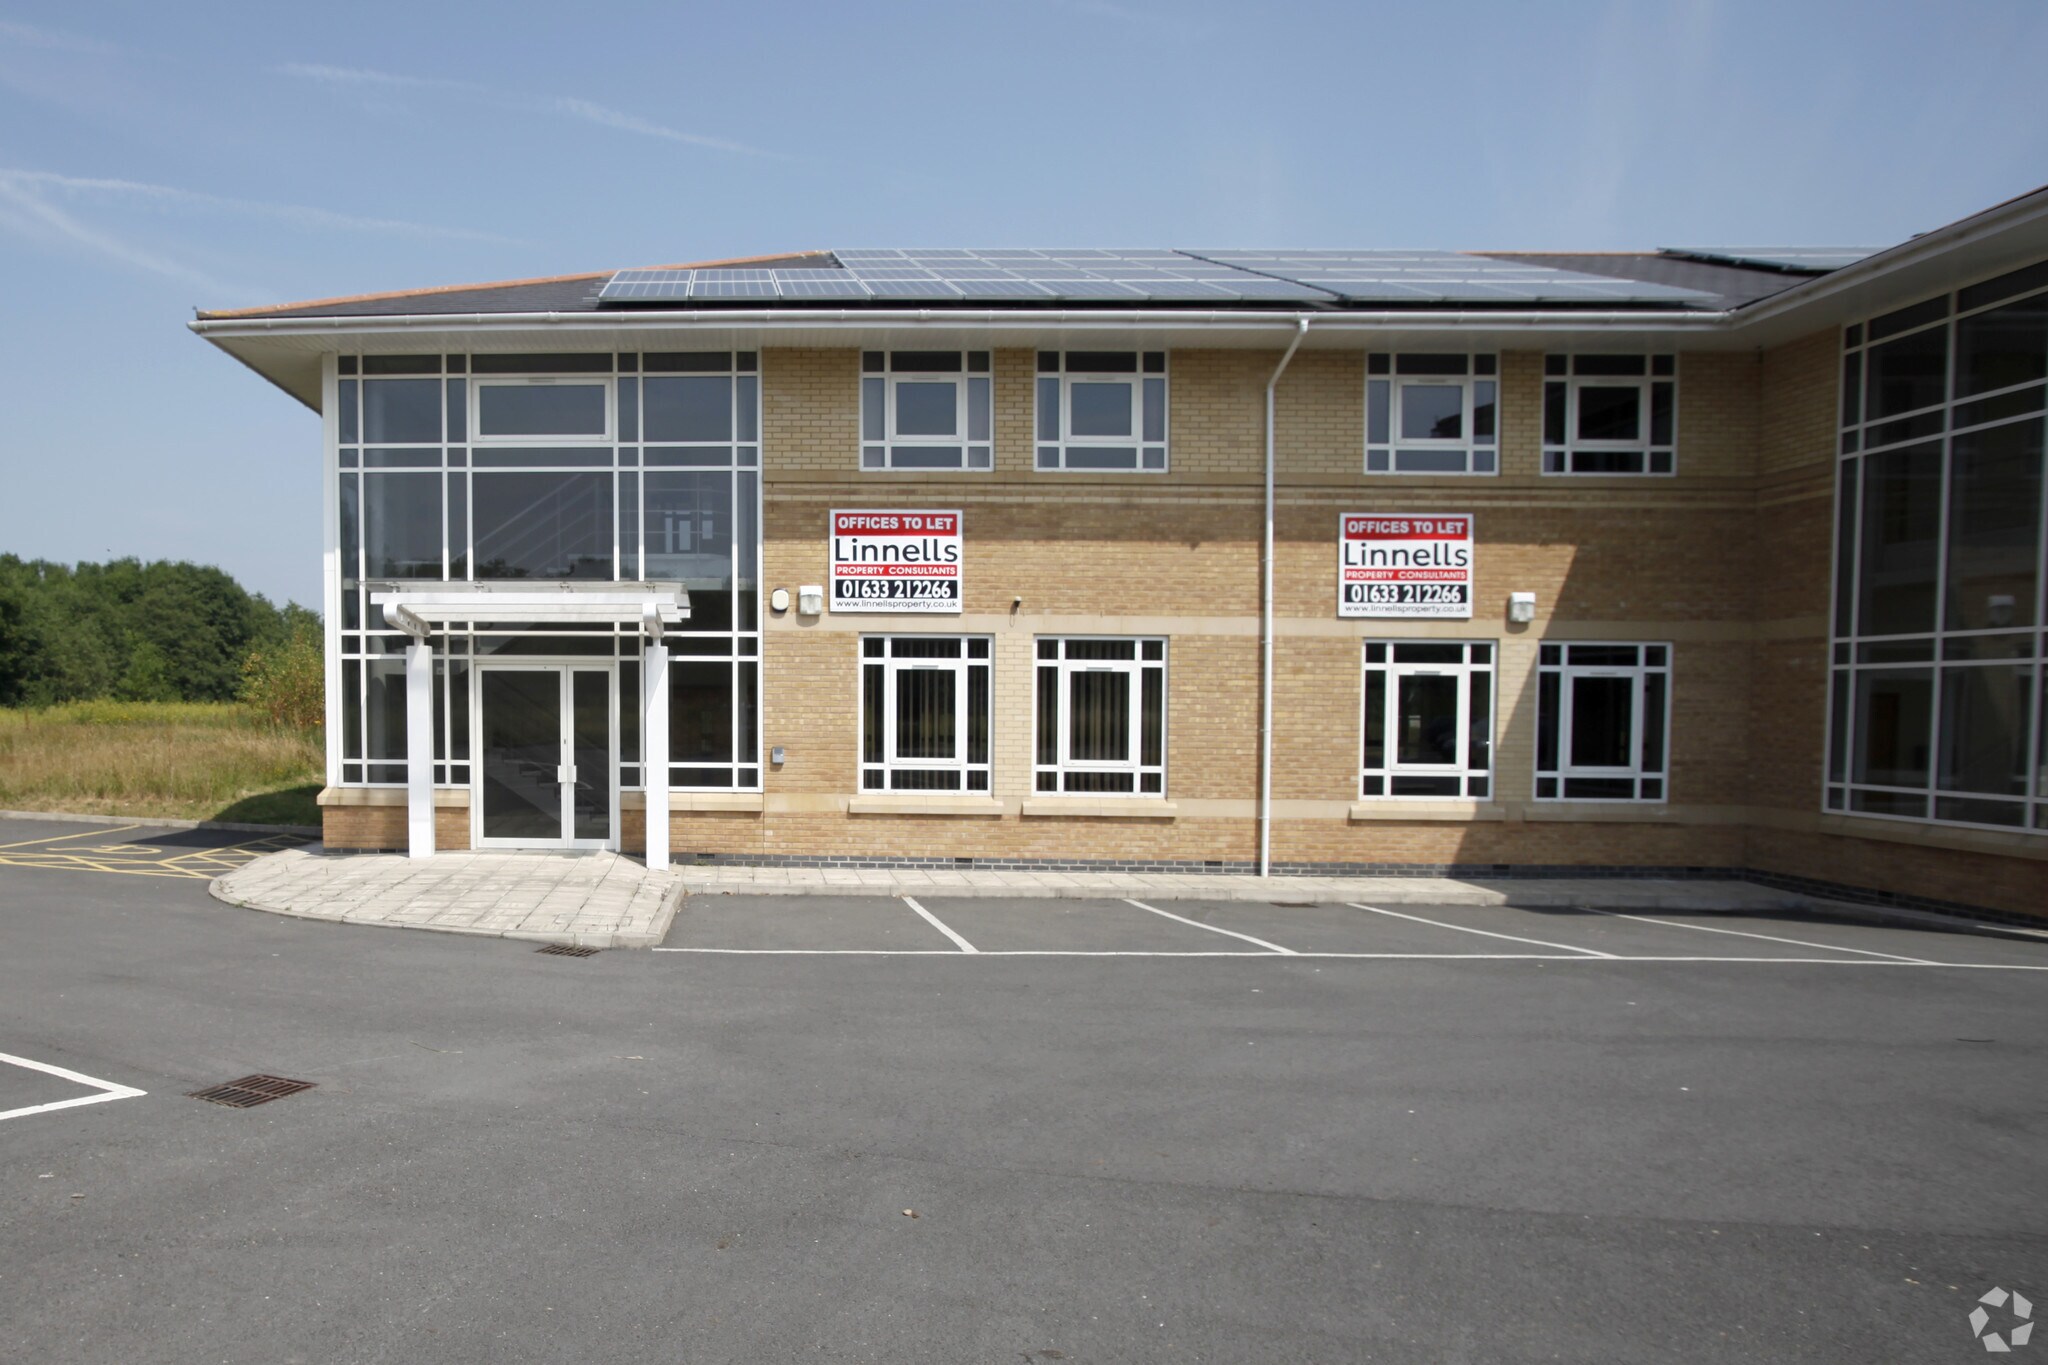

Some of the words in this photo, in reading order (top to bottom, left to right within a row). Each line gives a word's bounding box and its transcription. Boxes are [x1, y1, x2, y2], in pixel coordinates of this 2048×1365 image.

[837, 516, 899, 529] OFFICES
[903, 517, 922, 530] TO
[926, 518, 953, 530] LET
[1347, 521, 1409, 534] OFFICES
[1413, 521, 1433, 534] TO
[1437, 522, 1464, 534] LET
[835, 538, 958, 562] Linnells
[1344, 542, 1467, 567] Linnells
[836, 566, 884, 575] PROPERTY
[888, 566, 956, 575] CONSULTANTS
[1346, 571, 1394, 579] PROPERTY
[1398, 571, 1466, 579] CONSULTANTS
[842, 580, 889, 598] 01633
[894, 580, 951, 598] 212266
[1351, 584, 1399, 603] 01633
[1403, 584, 1461, 603] 212266
[836, 600, 957, 609] www.linnellsproperty.co.uk
[1345, 605, 1467, 613] www.linnellsproperty.co.uk
